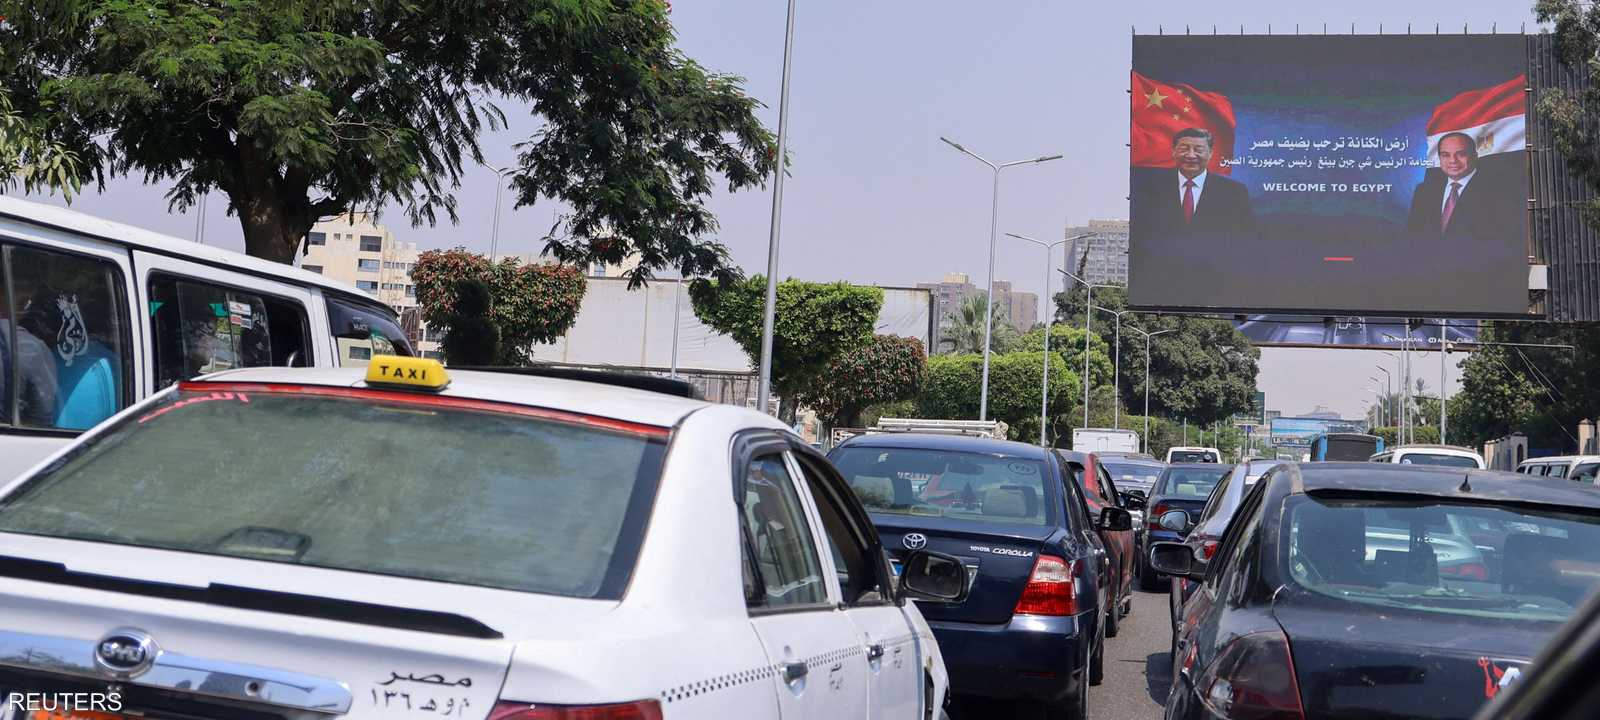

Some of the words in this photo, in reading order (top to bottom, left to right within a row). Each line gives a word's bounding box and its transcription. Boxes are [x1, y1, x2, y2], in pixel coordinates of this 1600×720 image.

[1250, 138, 1274, 150] مصر
[1278, 136, 1310, 151] بضيف
[1313, 137, 1345, 151] ترحب
[1347, 136, 1383, 149] الكنانة
[1385, 136, 1409, 151] أرض
[1219, 155, 1246, 167] الصين
[1247, 155, 1285, 168] جمهورية
[1288, 155, 1312, 168] رئيس
[1338, 156, 1355, 168] جين
[1358, 155, 1372, 170] شي
[1374, 156, 1406, 169] الرئيس
[1263, 183, 1326, 192] WELCOME
[1331, 183, 1348, 192] TO
[1352, 183, 1393, 192] EGYPT
[380, 365, 426, 380] TAXI
[970, 545, 990, 553] TOYOTA
[992, 547, 1034, 557] COROLLA
[375, 671, 472, 687] مصر
